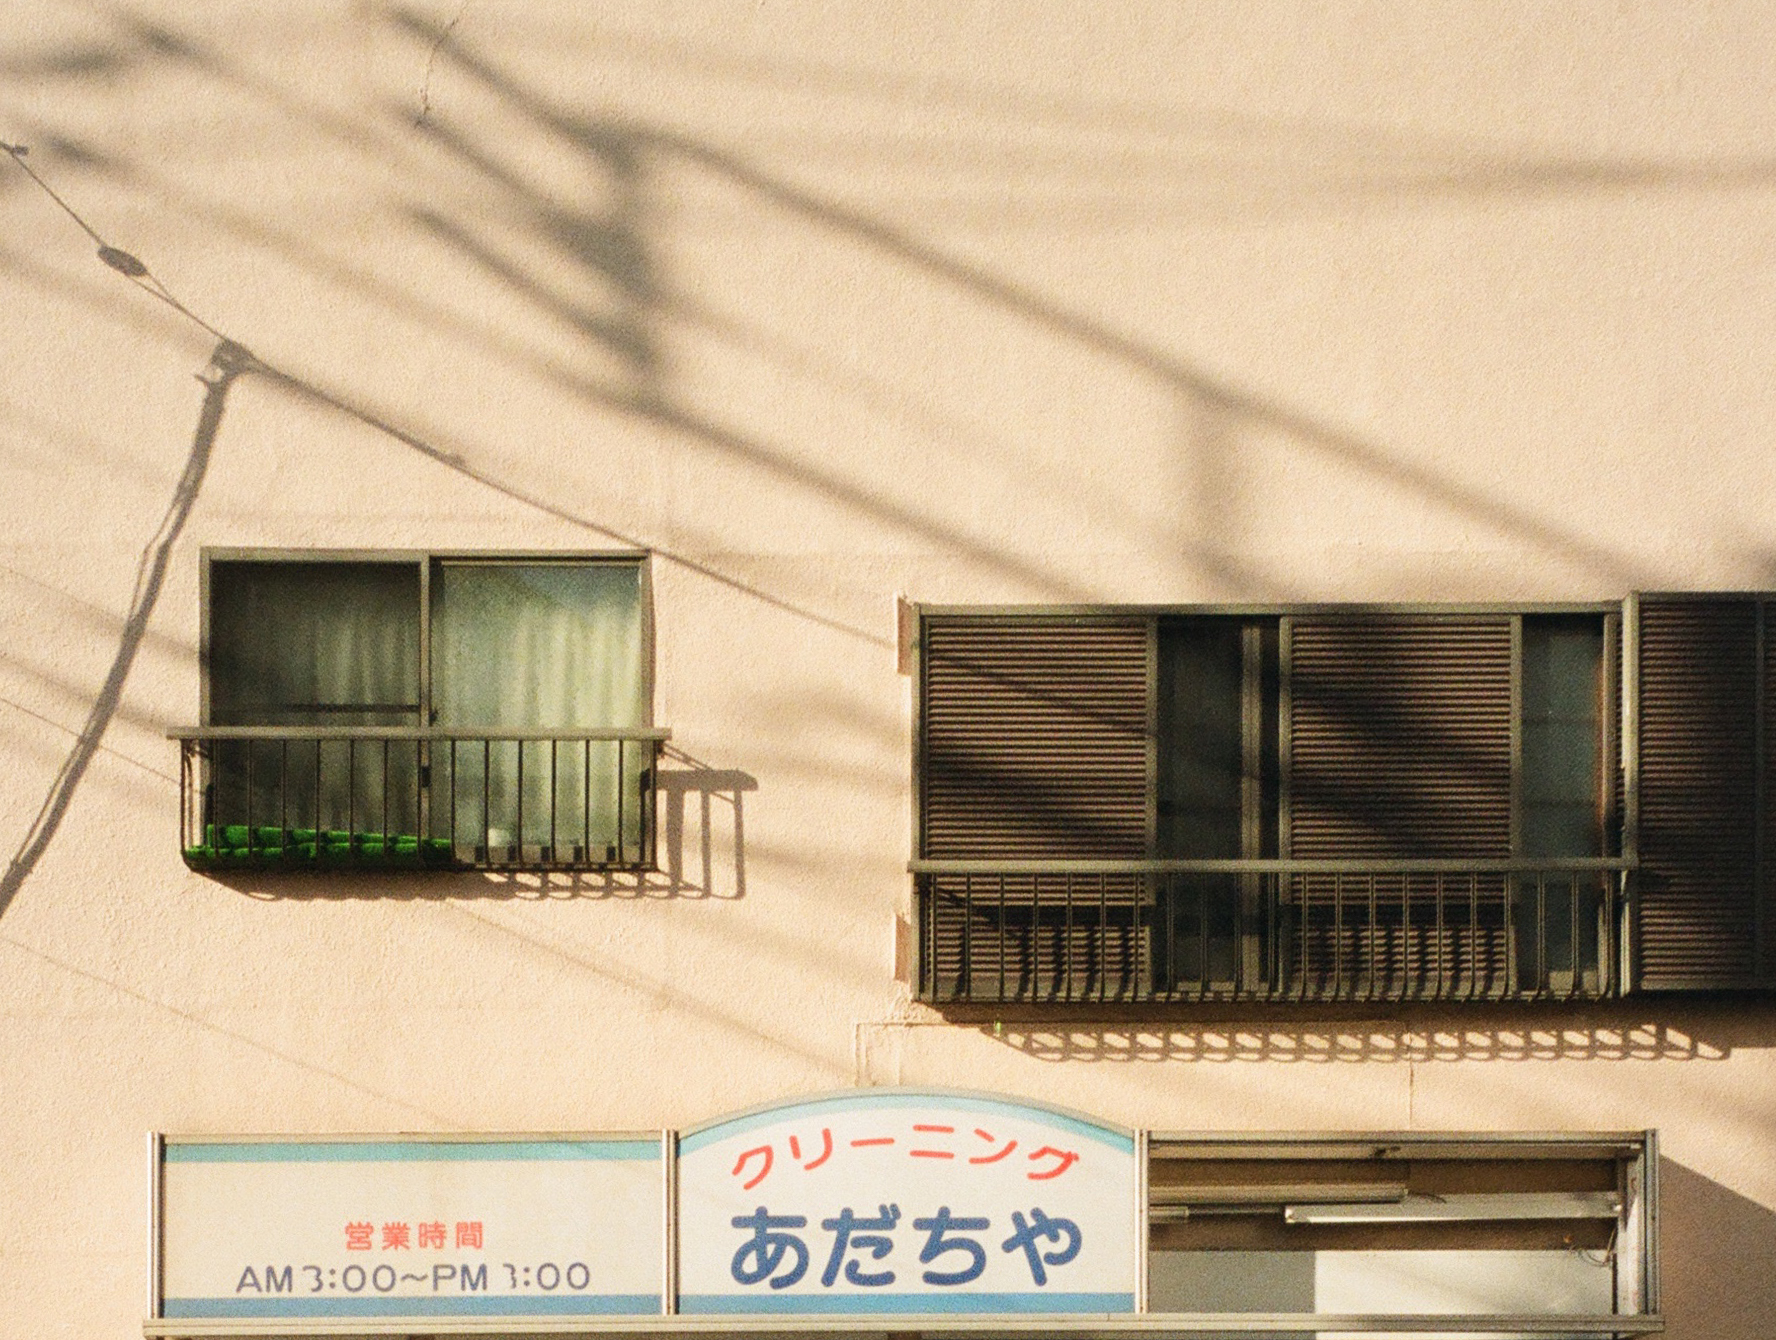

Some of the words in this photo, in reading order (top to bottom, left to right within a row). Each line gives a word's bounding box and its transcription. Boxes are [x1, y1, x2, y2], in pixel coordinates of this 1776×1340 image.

[732, 1124, 1079, 1190] クリーニング
[345, 1221, 483, 1250] 営業時間
[731, 1204, 1082, 1290] あだちや
